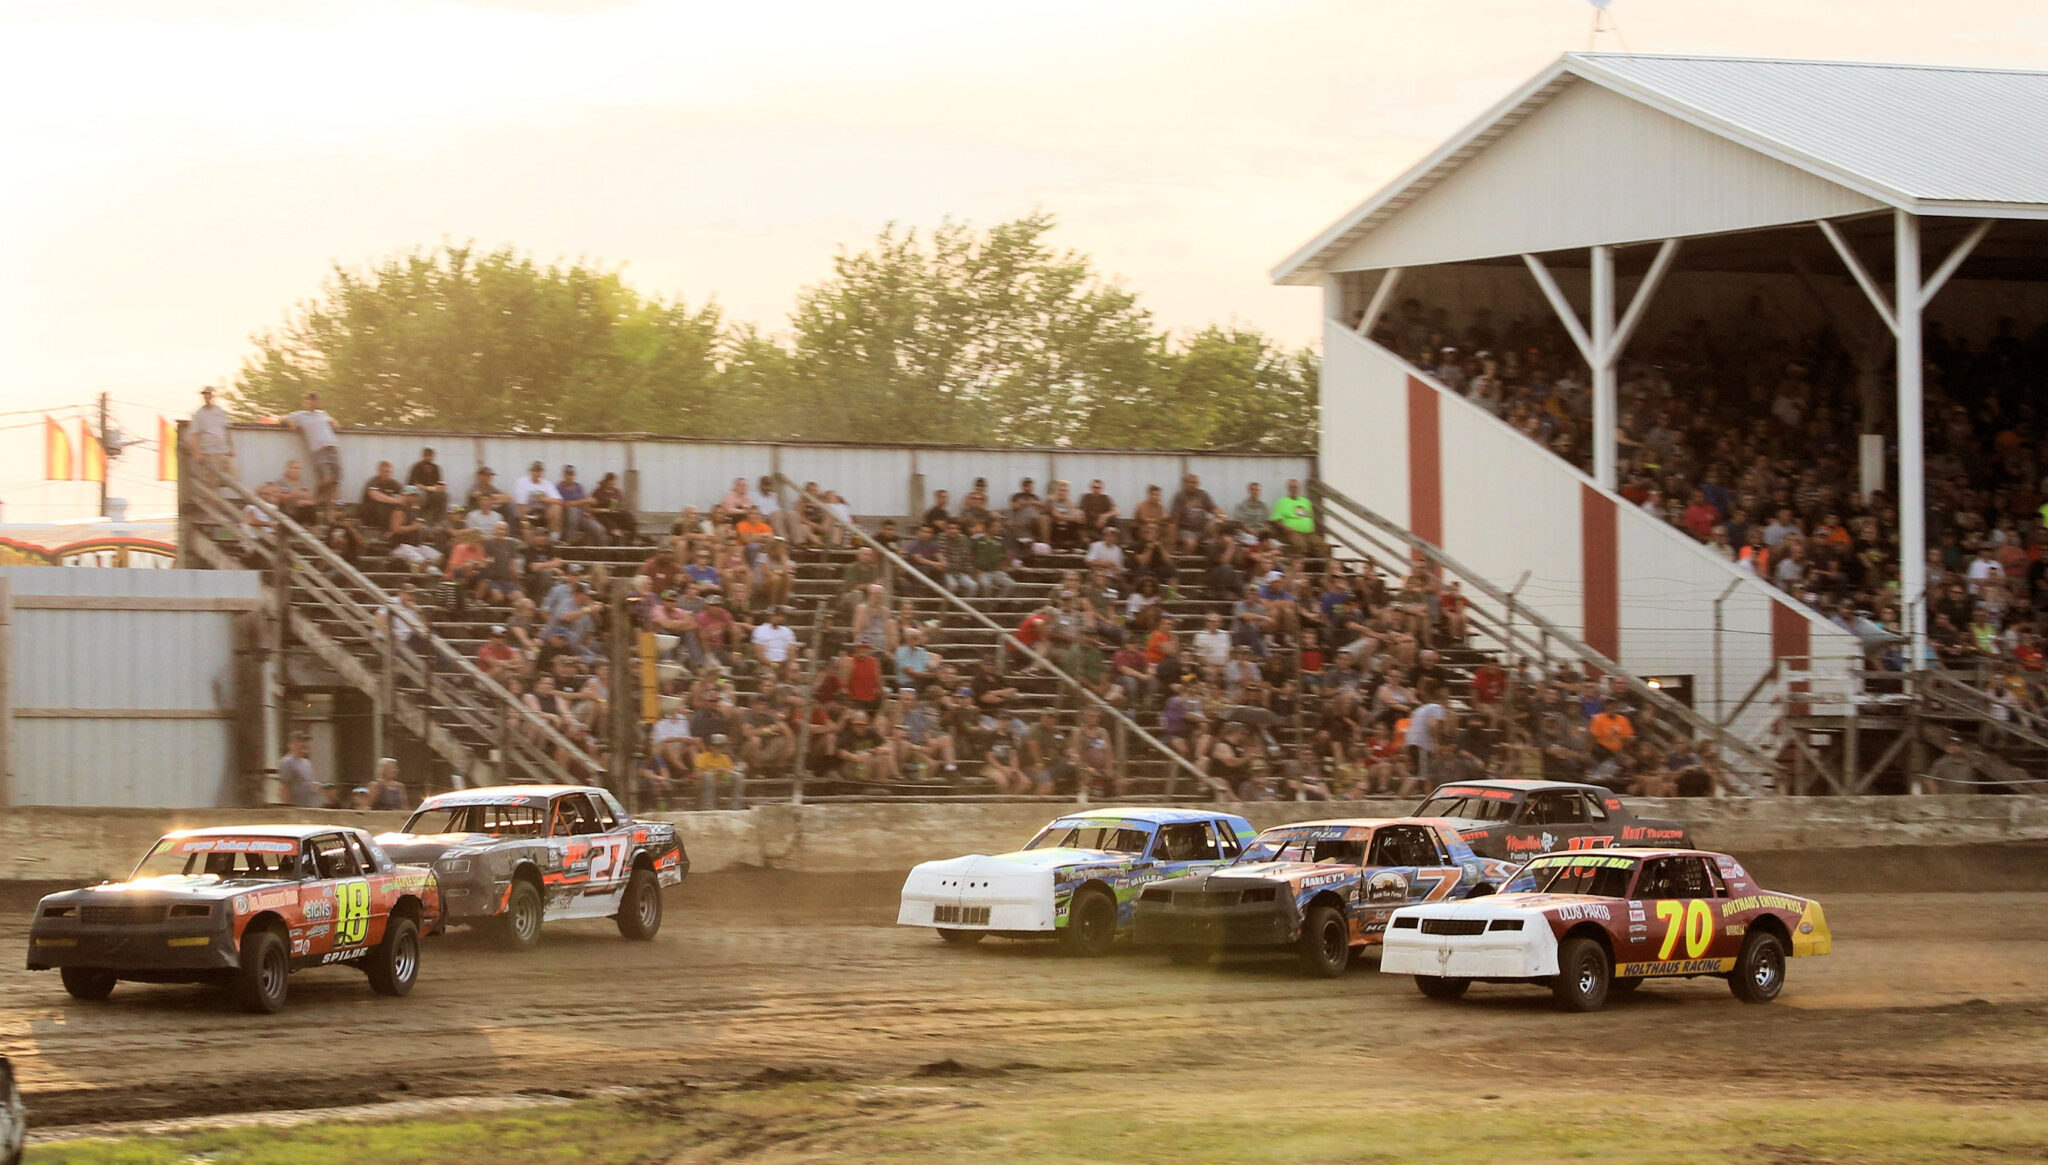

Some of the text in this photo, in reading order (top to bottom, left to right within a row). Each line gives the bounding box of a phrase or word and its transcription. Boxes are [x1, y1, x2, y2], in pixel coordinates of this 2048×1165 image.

[1311, 831, 1342, 839] PIZZA
[590, 833, 628, 881] 27
[1571, 856, 1609, 867] DIRTY
[1606, 858, 1635, 870] RAT
[1300, 872, 1346, 889] HARVEY'S
[1417, 867, 1463, 904] 7
[305, 902, 331, 919] SIGNS
[334, 881, 370, 948] 18
[1582, 904, 1611, 920] PARTS
[1721, 895, 1804, 917] HOLTHAUS ENTERPRISE
[1656, 898, 1714, 961] 70
[322, 947, 369, 964] SPILDE
[1624, 959, 1722, 976] HOLTHAUS RACING
